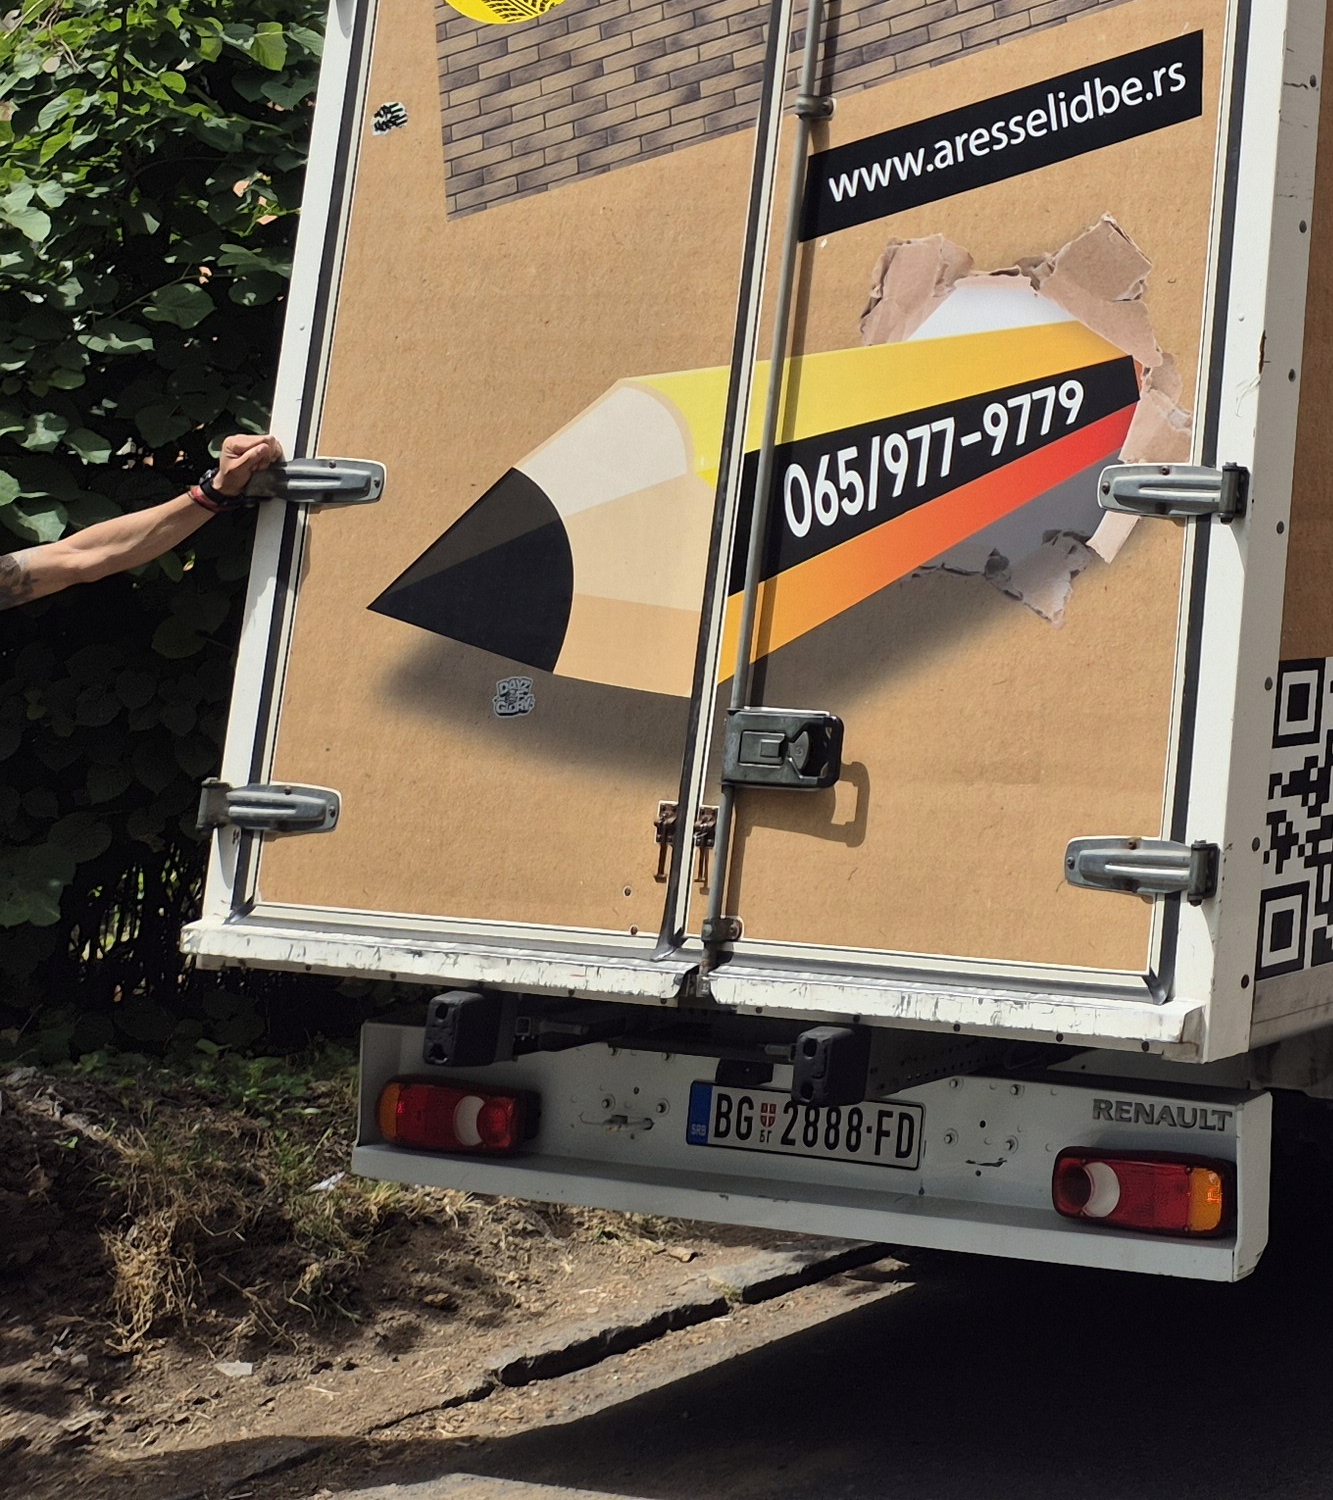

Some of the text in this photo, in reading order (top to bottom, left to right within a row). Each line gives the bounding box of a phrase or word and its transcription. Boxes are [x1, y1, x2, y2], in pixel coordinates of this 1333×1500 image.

[828, 61, 1187, 202] www.aresselidbe.rs
[784, 379, 1084, 538] 065/977-9779
[691, 1123, 708, 1137] SRB
[714, 1092, 755, 1141] BG
[1092, 1098, 1233, 1132] RENAULT
